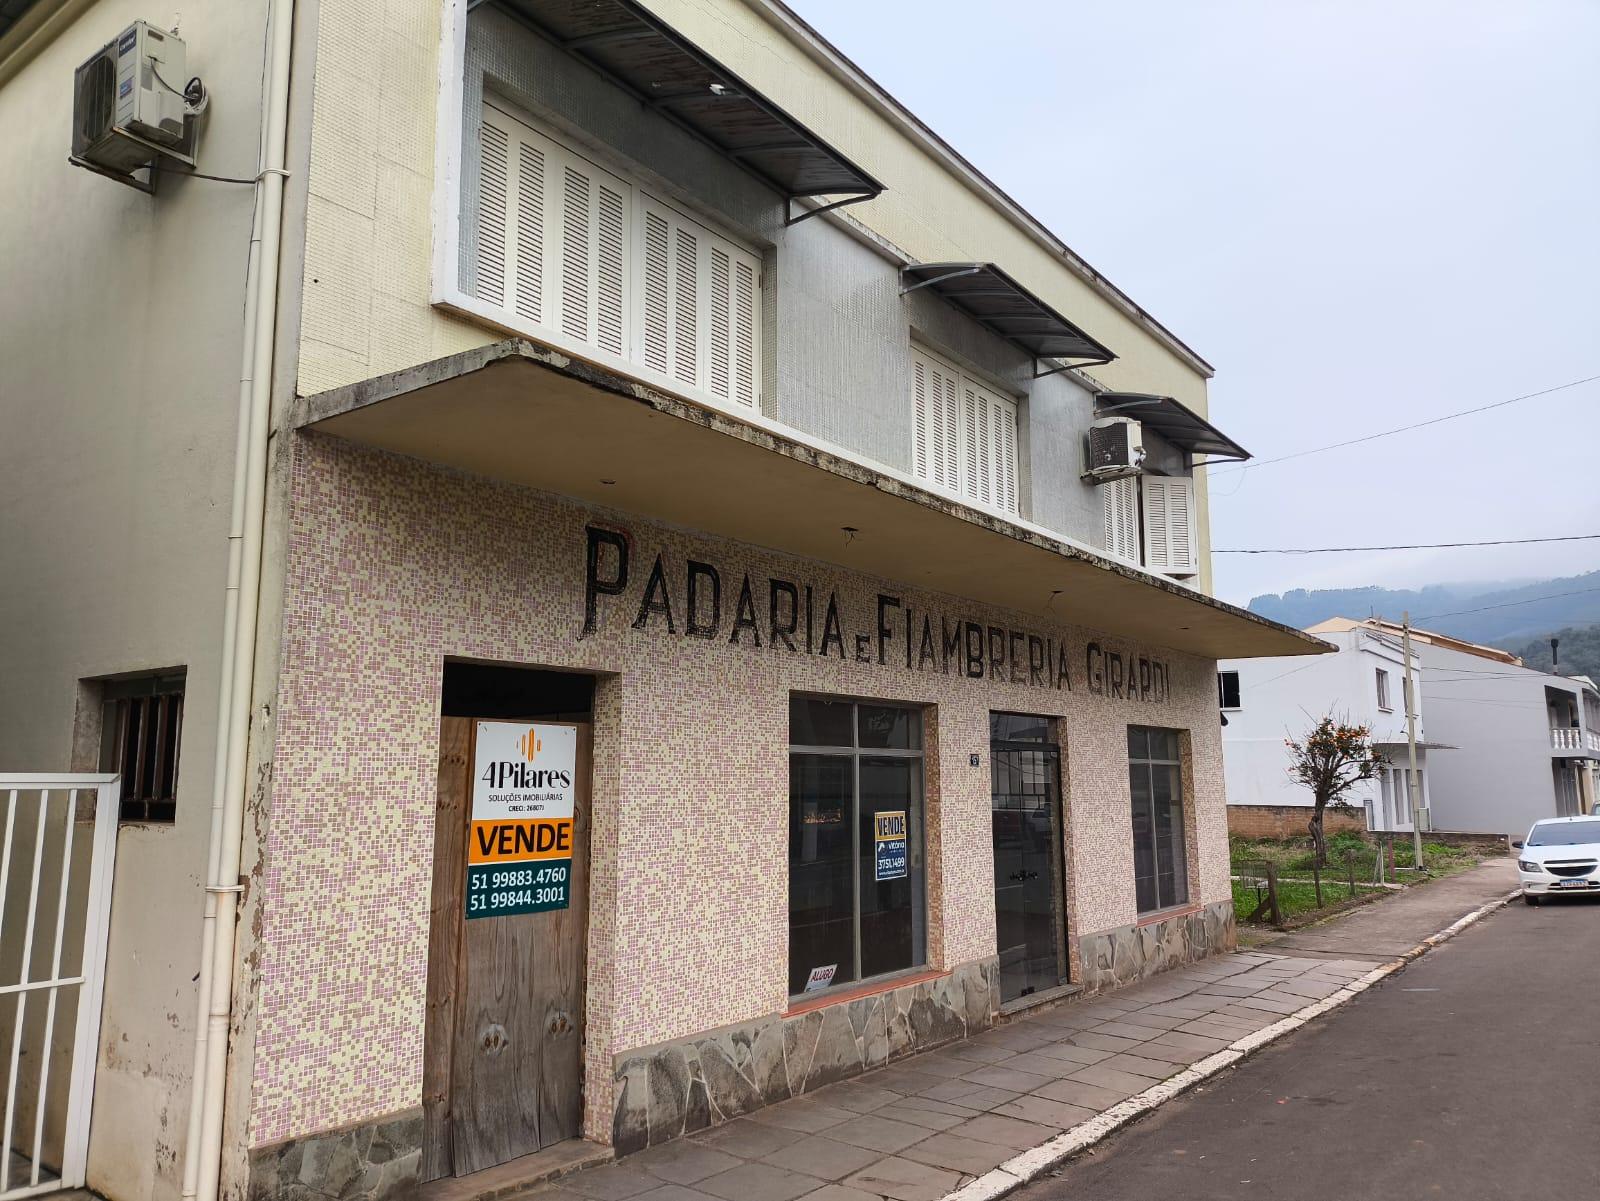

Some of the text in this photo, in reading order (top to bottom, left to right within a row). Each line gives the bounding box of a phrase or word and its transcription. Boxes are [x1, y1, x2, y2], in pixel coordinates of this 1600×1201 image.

[576, 524, 846, 660] PADARIA
[877, 593, 1072, 691] FIAMBRERIA
[1086, 641, 1171, 705] GIRARDI
[481, 761, 571, 789] 4Pilares
[488, 793, 563, 803] SOLUÇÕES IMOBILIÁRIAS
[878, 816, 905, 836] VENDE
[477, 822, 570, 856] VENDE
[471, 867, 566, 890] 51 99883.4760
[470, 886, 565, 910] 51 99844.3001
[810, 967, 834, 982] ALUGO
